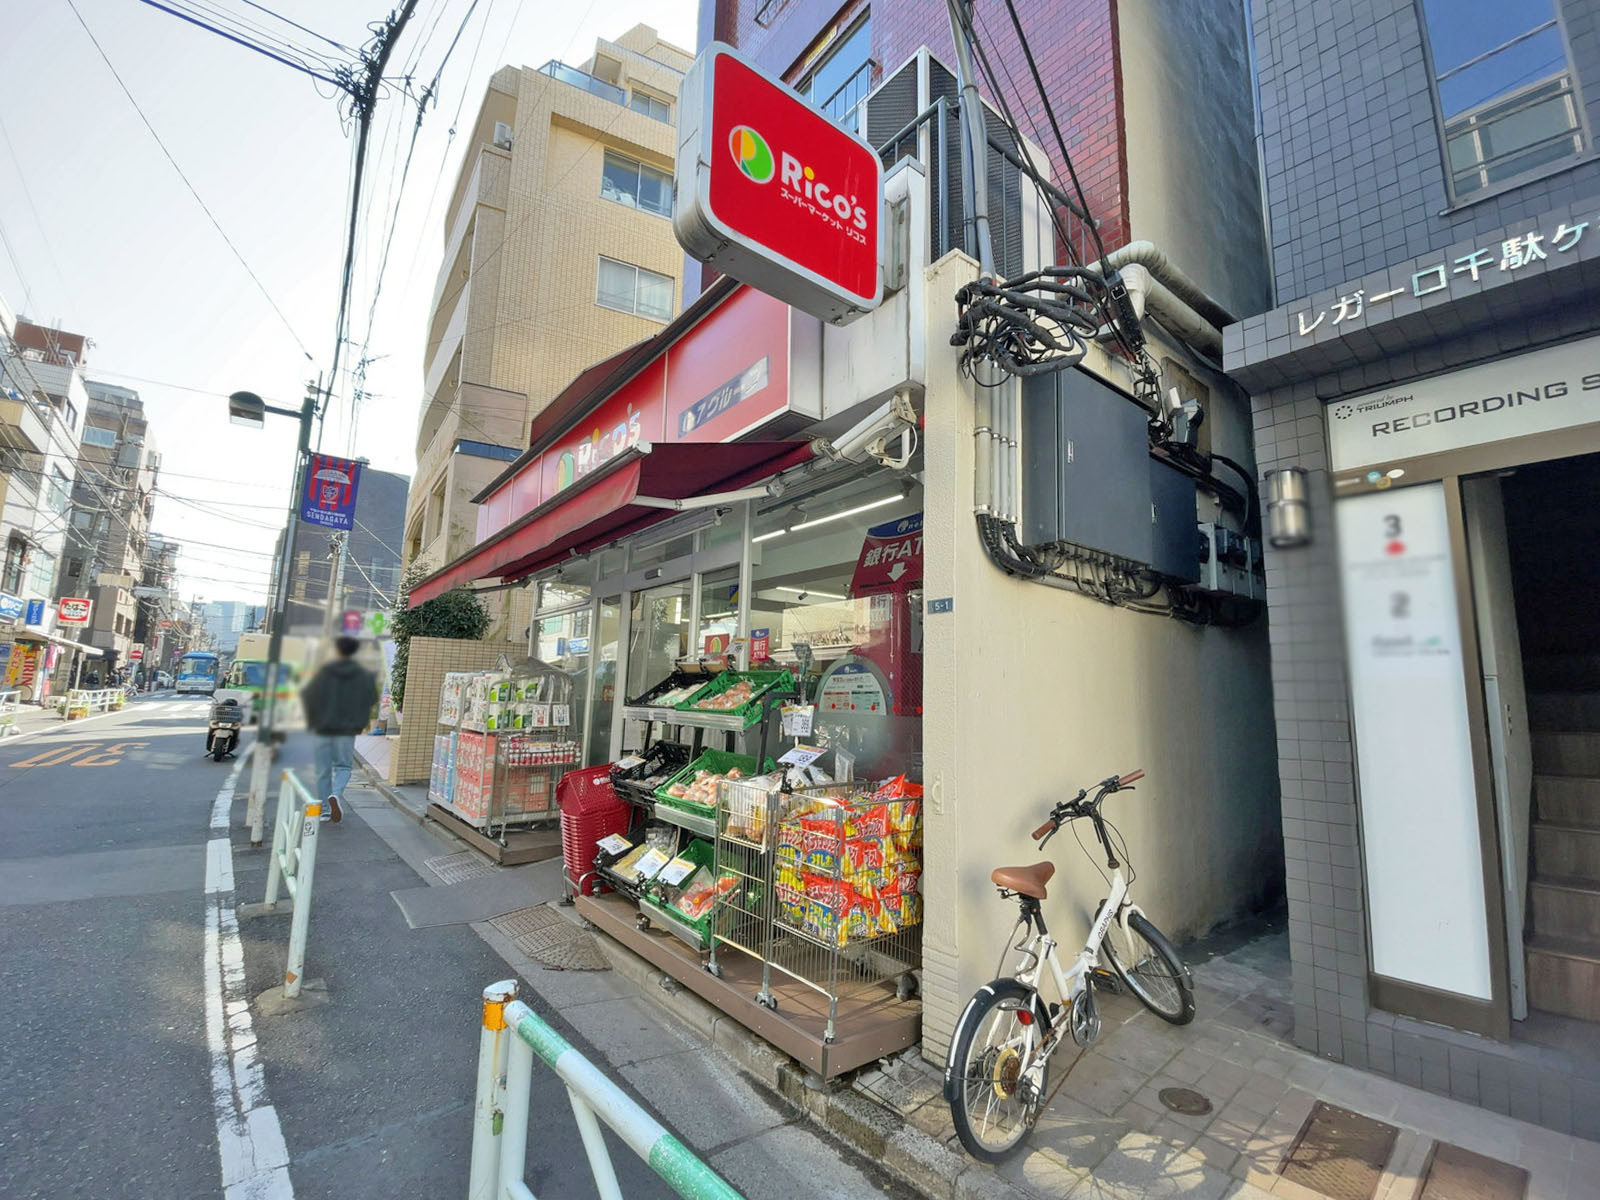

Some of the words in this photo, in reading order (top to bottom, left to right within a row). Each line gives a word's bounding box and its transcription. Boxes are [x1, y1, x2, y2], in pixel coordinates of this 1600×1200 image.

[781, 151, 867, 230] Rico's
[780, 187, 843, 230] スーパーマーケット
[846, 226, 867, 245] リコス
[1297, 217, 1600, 336] レガーロ千駄ケ
[1356, 395, 1413, 414] TRIUMPH
[1372, 381, 1568, 437] RECORDING
[306, 510, 348, 525] SENDAGAYA
[1383, 513, 1402, 538] 3
[934, 601, 949, 611] 5-1
